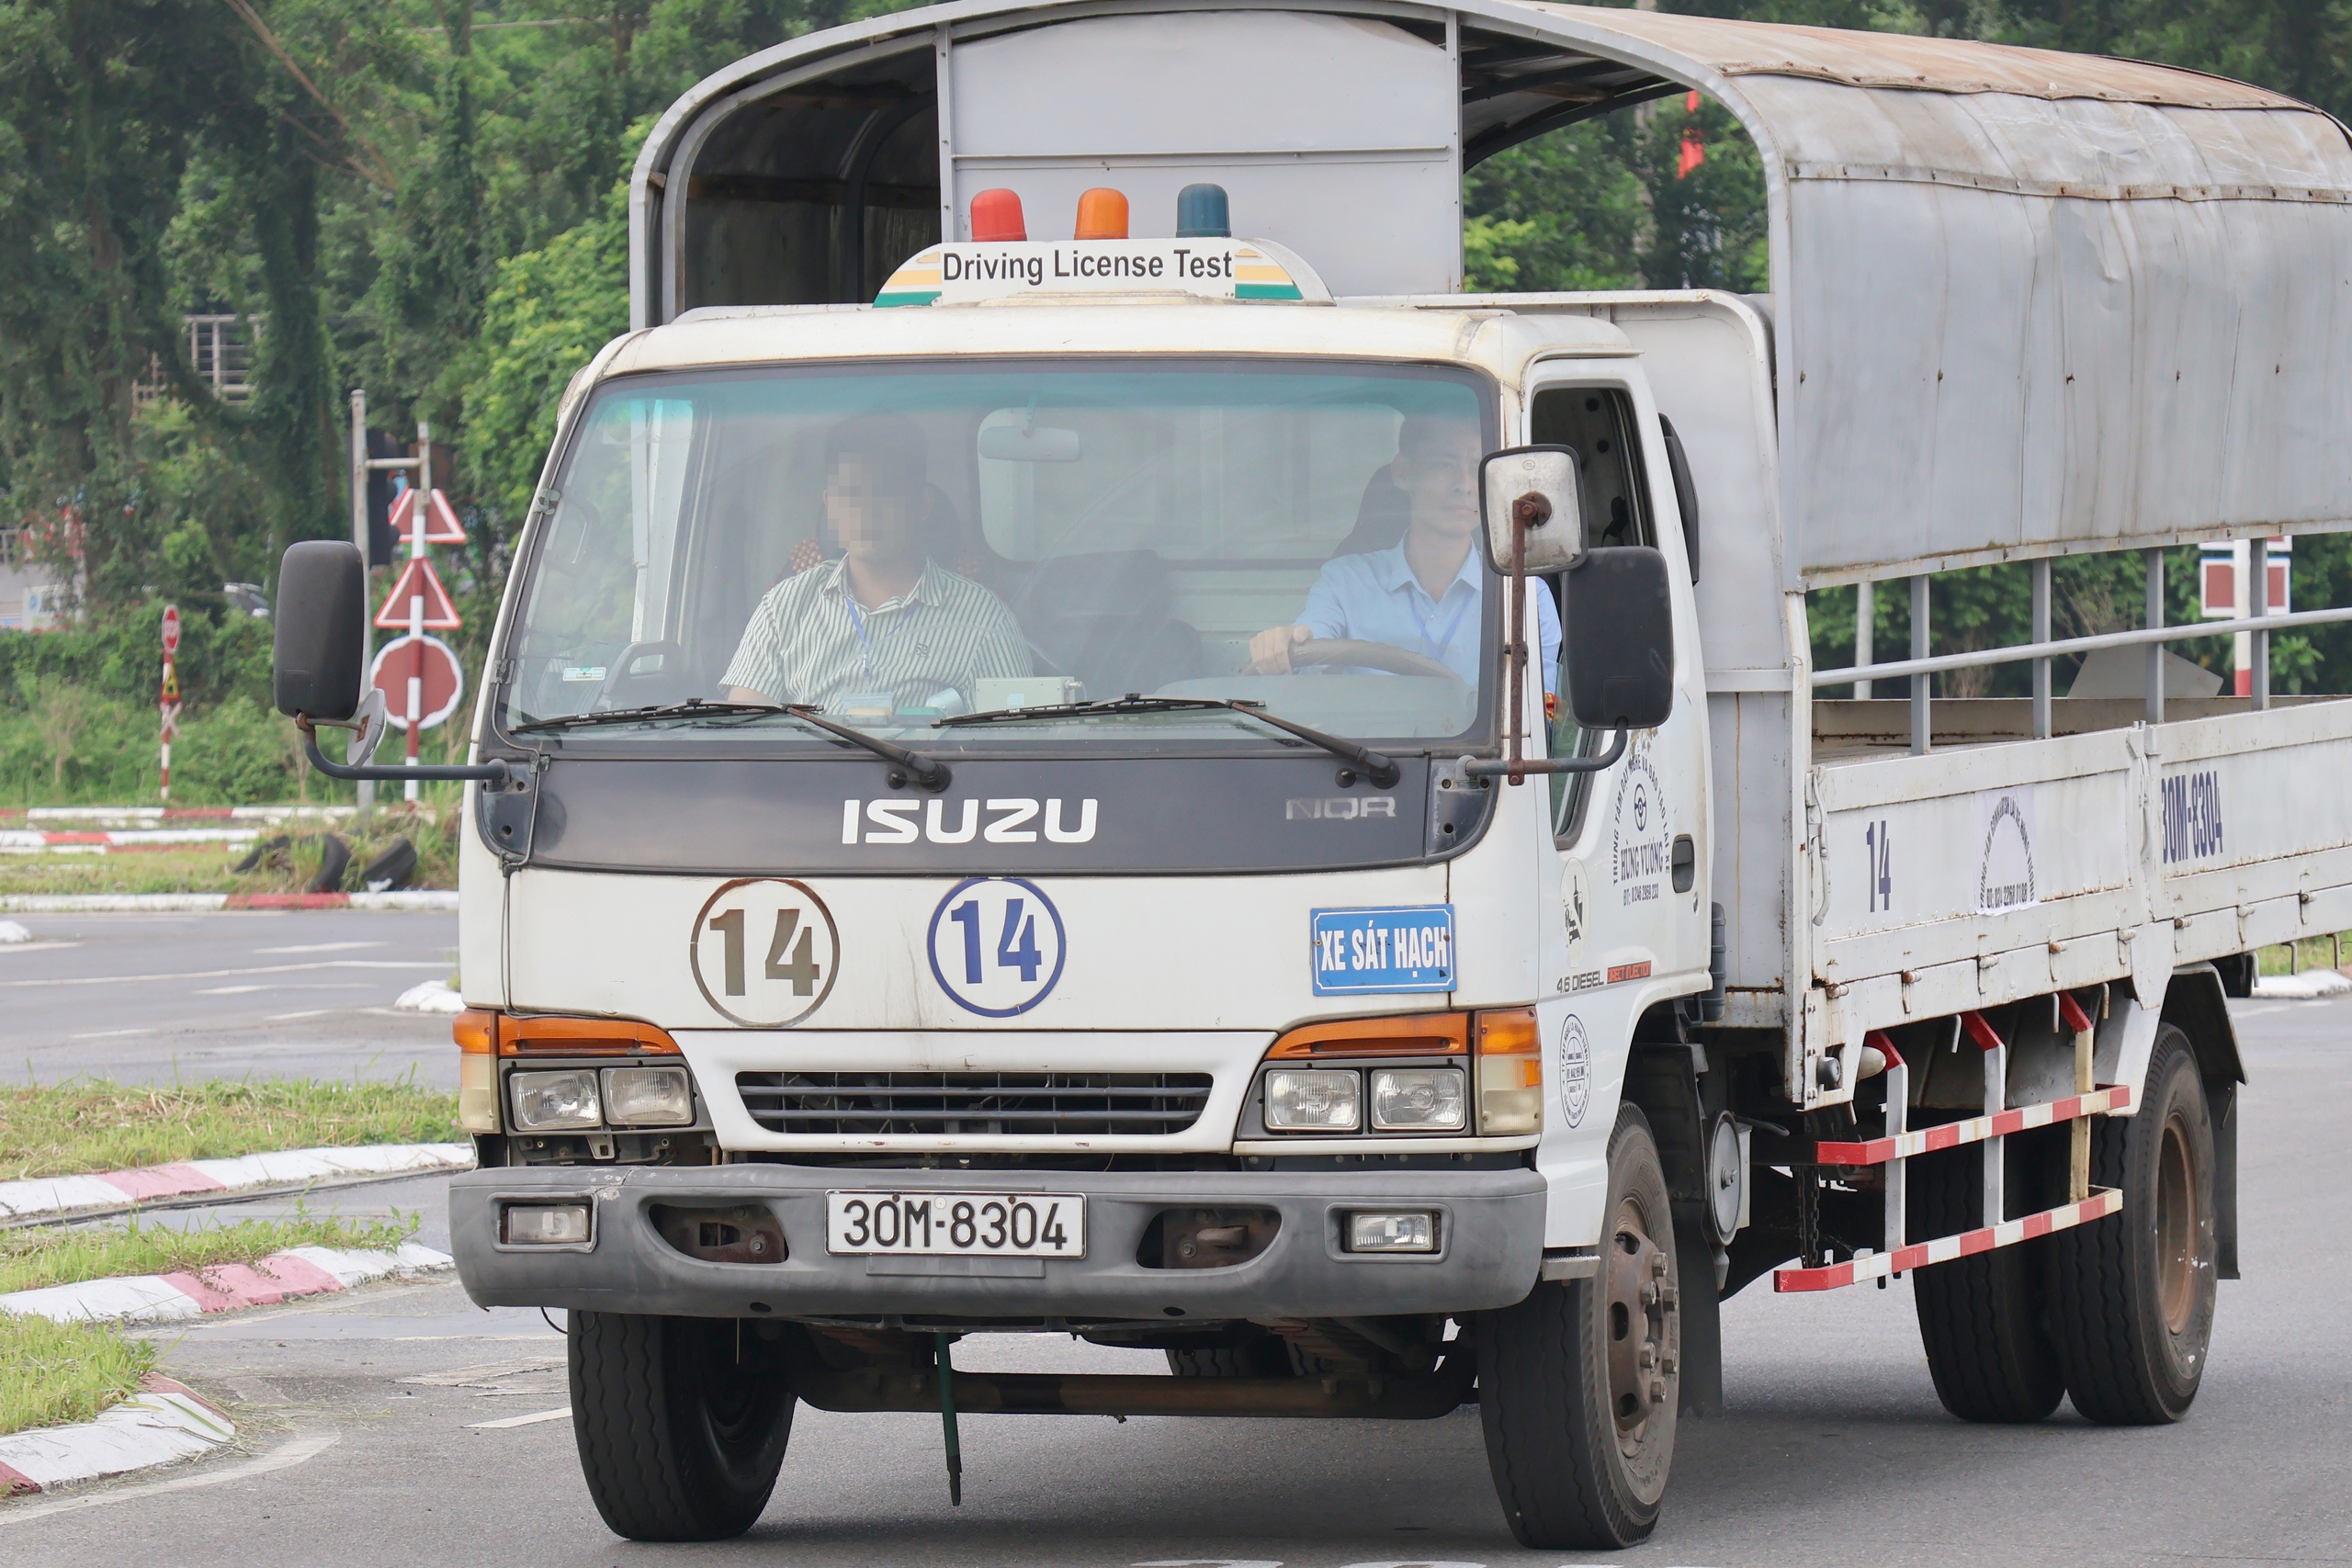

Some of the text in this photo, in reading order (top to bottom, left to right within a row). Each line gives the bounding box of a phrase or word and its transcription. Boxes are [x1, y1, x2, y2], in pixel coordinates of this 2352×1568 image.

[943, 248, 1233, 287] Driving License Test
[842, 798, 1098, 844] ISUZU
[1286, 796, 1396, 819] NQR
[2161, 771, 2223, 864] 30M-8304
[1866, 820, 1892, 912] 14
[709, 908, 820, 997] 14
[951, 897, 1043, 985] 14
[1319, 919, 1448, 978] XE SÁT HẠCH
[1572, 970, 1604, 991] DIESEL
[843, 1199, 1068, 1250] 30M-8304
